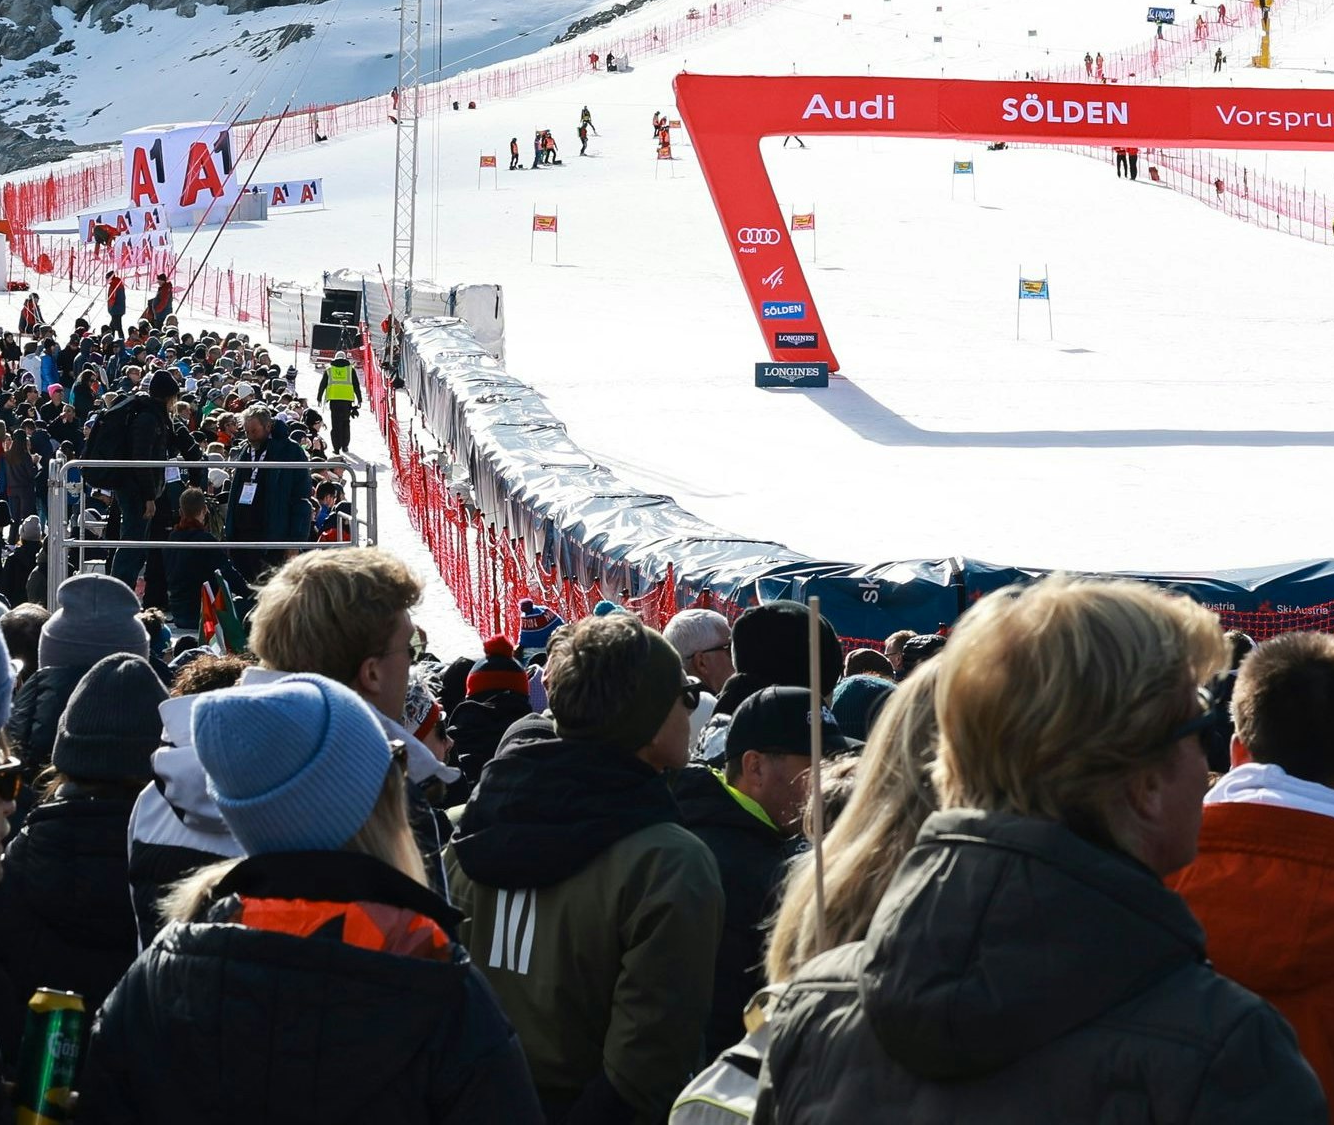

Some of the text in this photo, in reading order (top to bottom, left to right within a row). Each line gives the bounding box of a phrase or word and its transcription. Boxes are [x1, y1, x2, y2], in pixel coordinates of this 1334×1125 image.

[802, 93, 896, 120] Audi
[1002, 93, 1128, 125] SÖLDEN
[131, 138, 165, 207] A1
[180, 130, 233, 207] A1
[271, 181, 317, 206] A1 A1
[116, 210, 132, 235] A1
[144, 208, 160, 231] A1
[764, 304, 802, 316] SÖLDEN
[764, 367, 819, 377] LONGINES
[1276, 604, 1329, 616] Ski Austria
